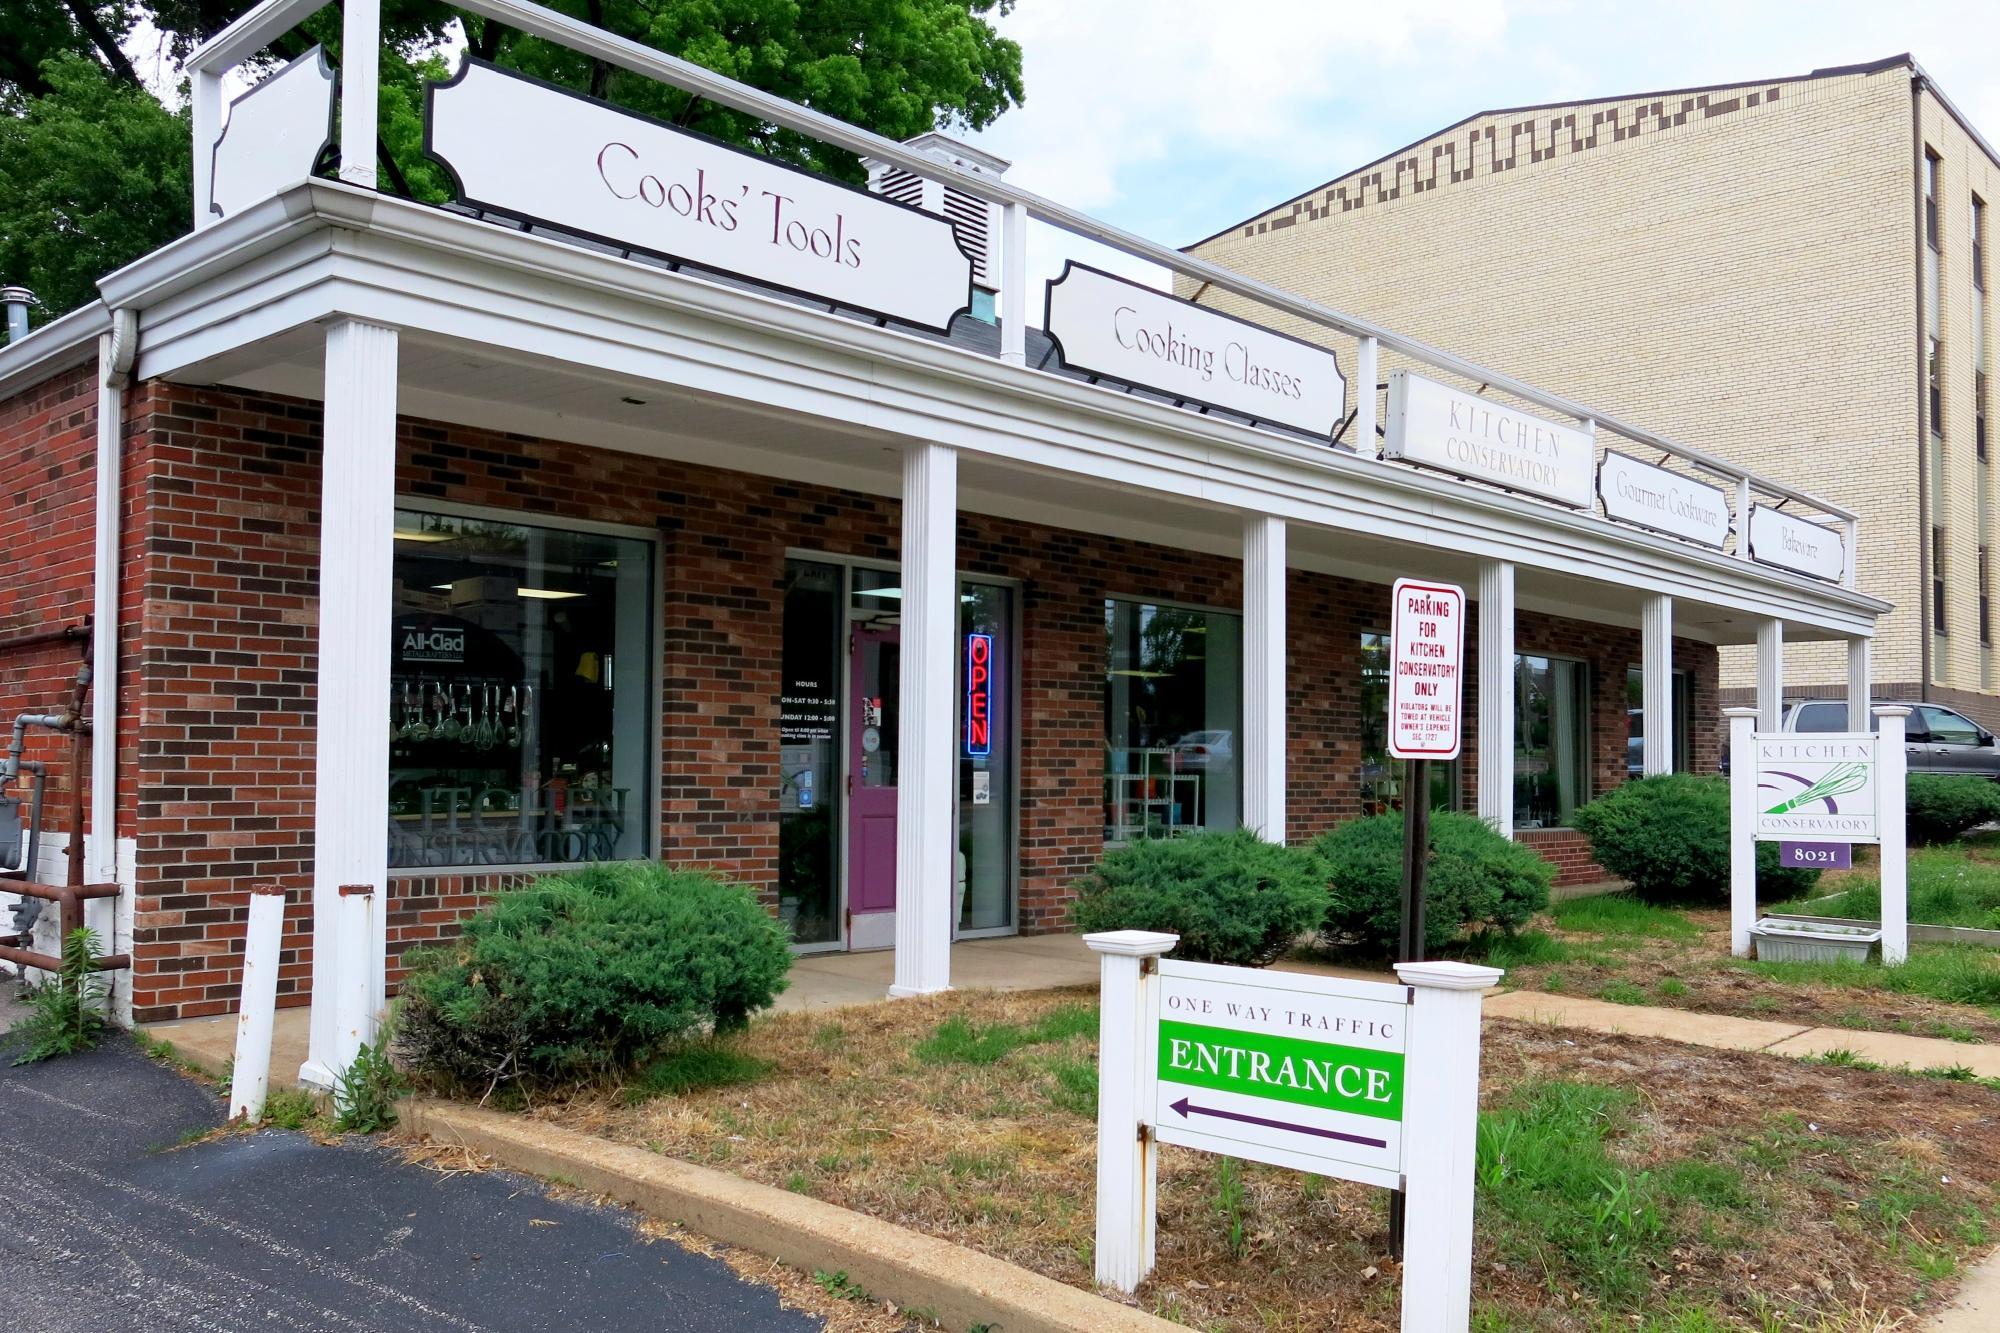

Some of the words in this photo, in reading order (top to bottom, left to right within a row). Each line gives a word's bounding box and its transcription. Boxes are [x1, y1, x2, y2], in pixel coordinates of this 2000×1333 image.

[596, 141, 749, 233] Cooks'
[761, 191, 863, 270] Tools
[1113, 305, 1215, 383] Cooking
[1224, 341, 1302, 401] Classes
[1449, 399, 1560, 459] KITCHEN
[1446, 436, 1560, 488] CONSERVATORY
[1616, 469, 1666, 511] Gourmet
[1668, 486, 1719, 528] Cookware
[1781, 525, 1818, 560] Bakeware
[1408, 597, 1450, 618] PARKING
[1419, 621, 1437, 638] FOR
[402, 631, 465, 652] All-Clad
[1410, 641, 1446, 658] KITCHEN
[1399, 660, 1456, 679] CONSERVATORY
[971, 636, 988, 746] OPEN
[1414, 681, 1439, 697] ONLY
[1400, 702, 1428, 711] VIOLATORS
[1430, 703, 1443, 712] WILL
[1445, 704, 1452, 713] BE
[1400, 712, 1419, 720] TOWED
[1420, 713, 1427, 721] AT
[1429, 713, 1451, 722] VEHICLE
[1400, 722, 1424, 731] OWNER'S
[1425, 723, 1450, 732] EXPENSE
[1762, 745, 1871, 759] KITCHEN
[389, 786, 631, 836] ITCHEN
[1761, 817, 1871, 831] CONSERVATORY
[1794, 848, 1837, 862] 8021
[1167, 995, 1214, 1014] ONE
[1226, 1002, 1272, 1022] WAY
[1284, 1010, 1394, 1039] TRAFFIC
[1168, 1038, 1393, 1103] ENTRANCE
